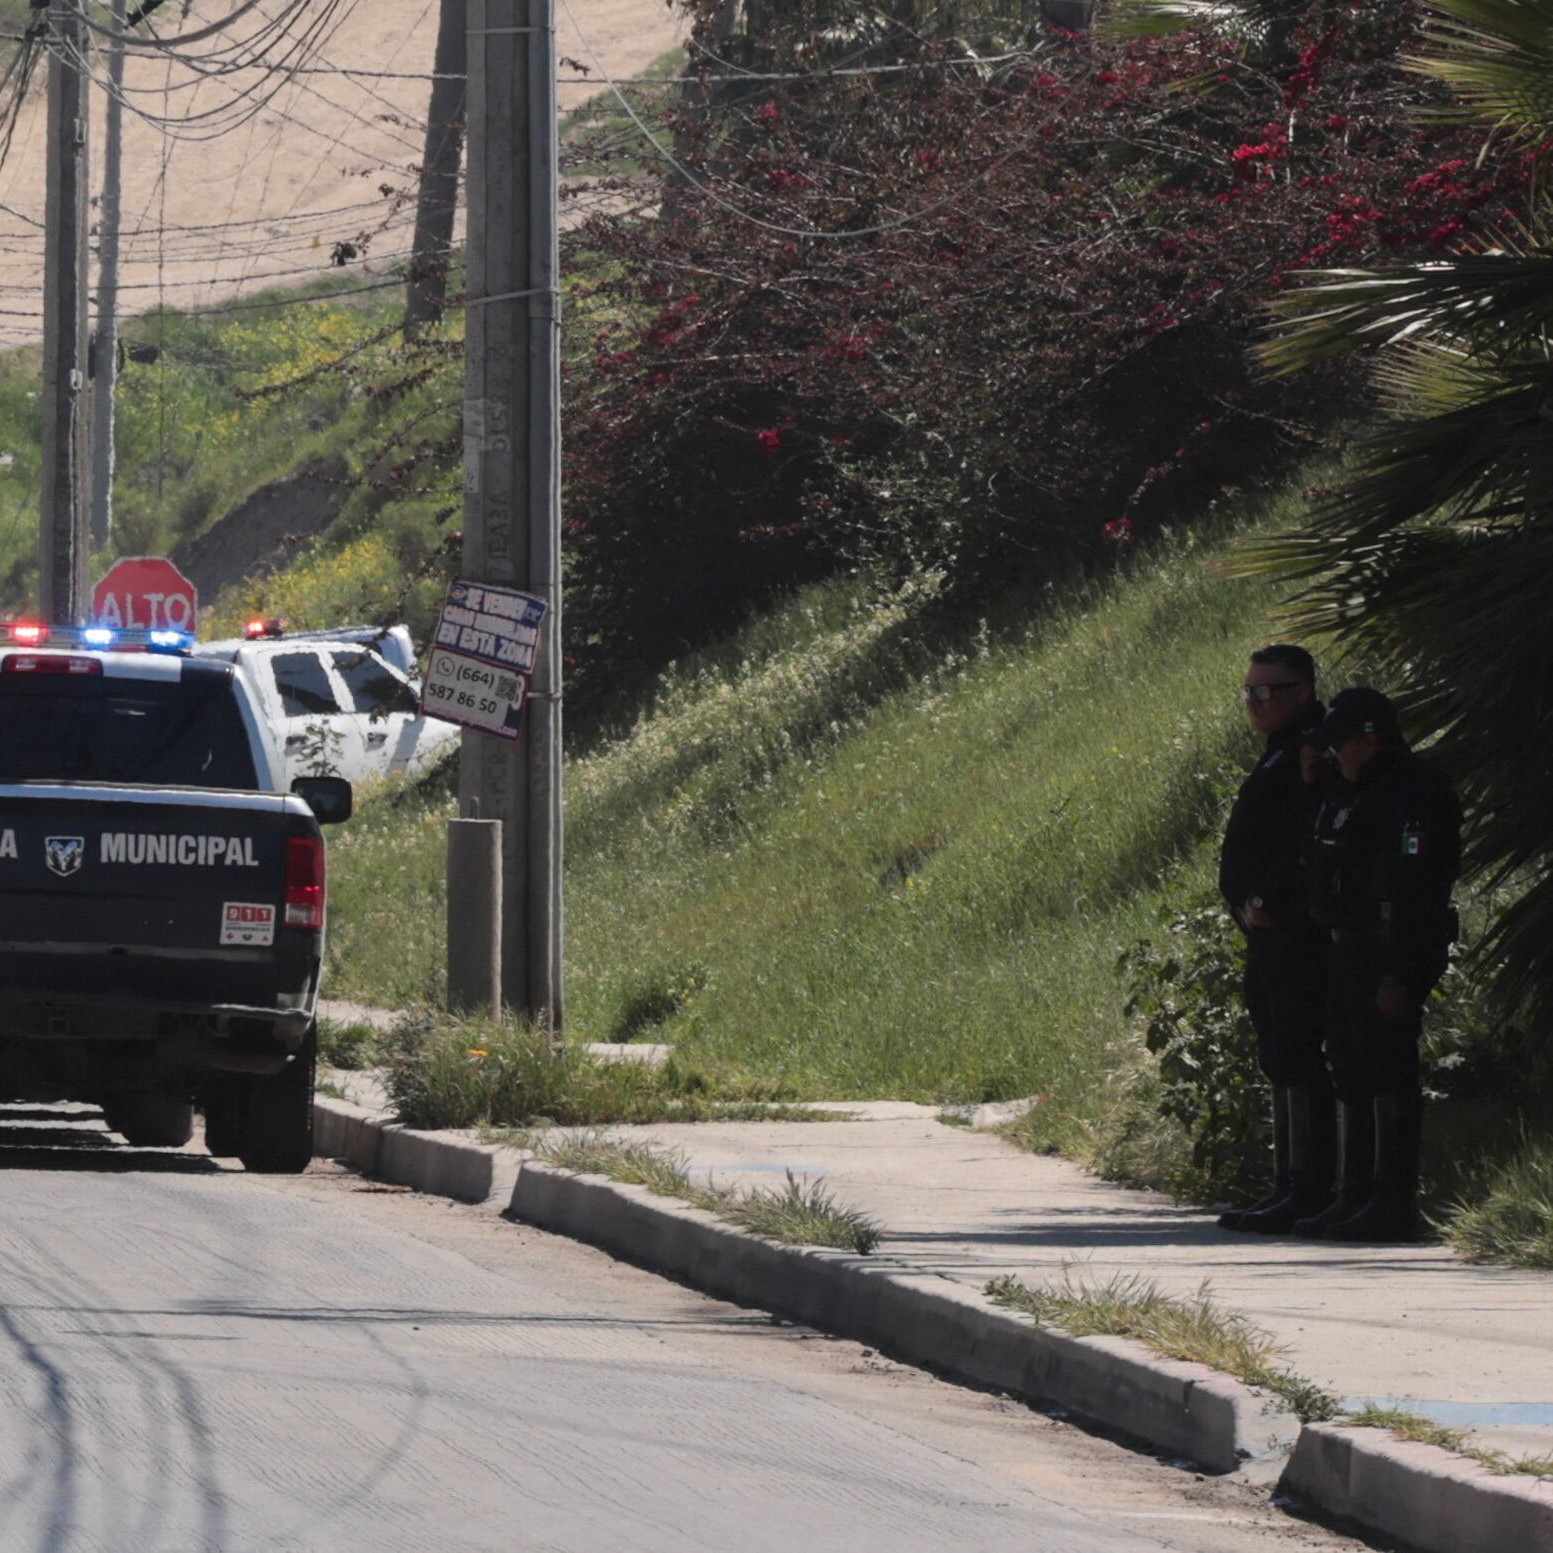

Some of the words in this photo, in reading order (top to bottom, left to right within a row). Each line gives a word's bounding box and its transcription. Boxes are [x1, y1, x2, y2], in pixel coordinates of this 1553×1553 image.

[98, 592, 192, 630] ALTO
[459, 626, 497, 658] ESTA
[456, 665, 495, 689] (664)
[429, 683, 454, 701] 587
[457, 691, 475, 708] 86
[478, 699, 497, 714] 50
[100, 832, 259, 867] MUNICIPAL
[229, 907, 268, 920] 911
